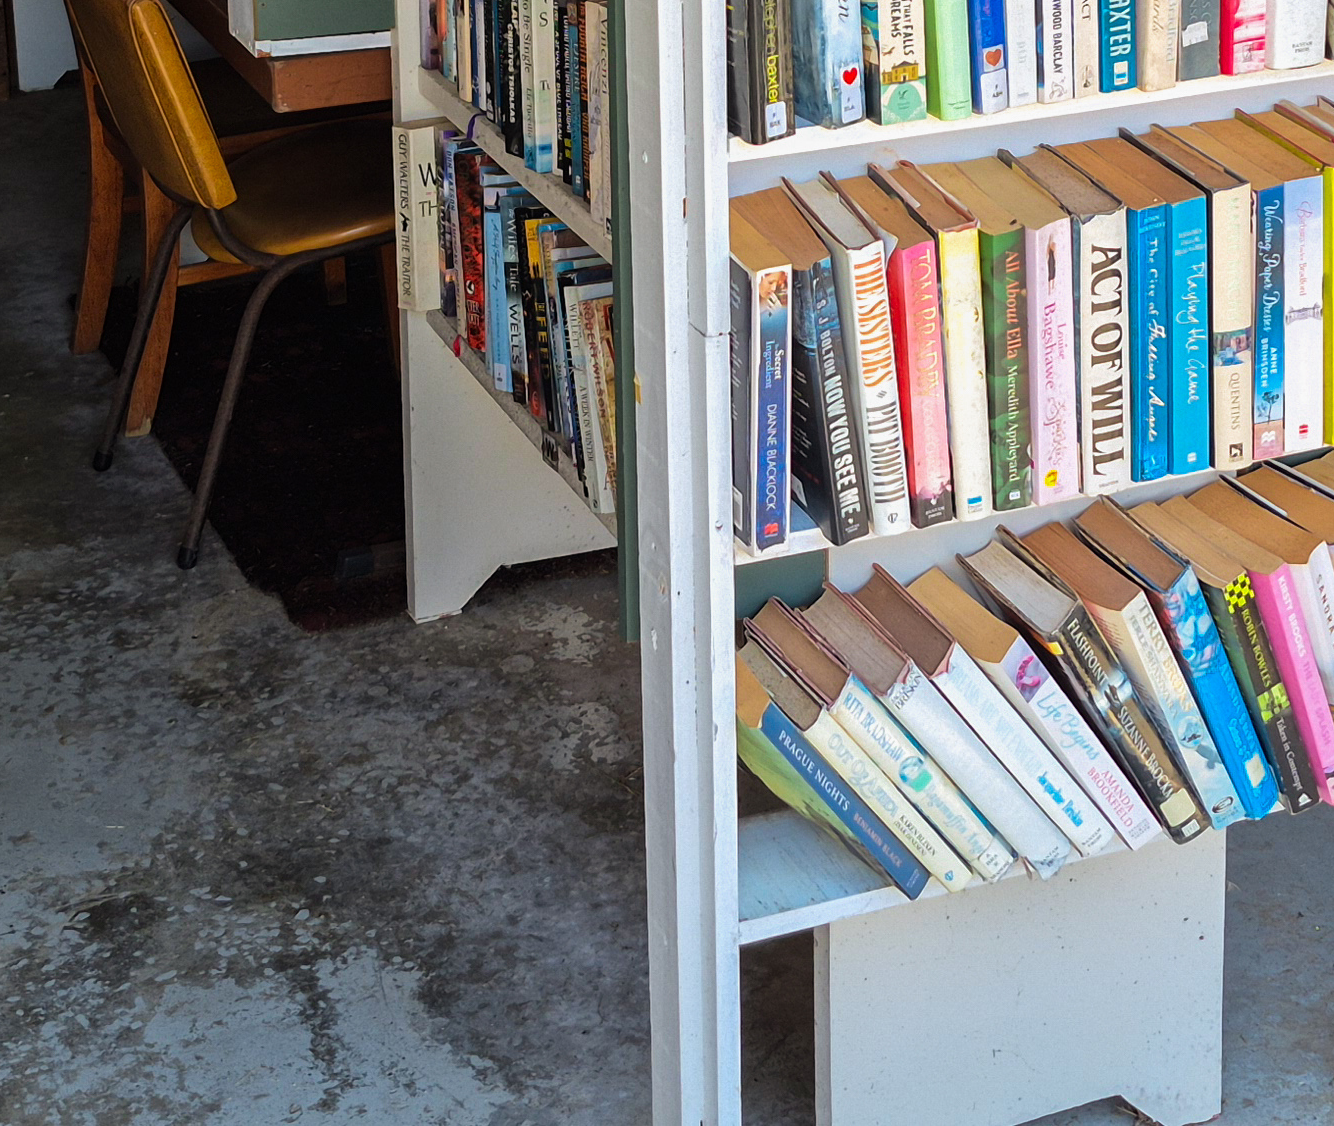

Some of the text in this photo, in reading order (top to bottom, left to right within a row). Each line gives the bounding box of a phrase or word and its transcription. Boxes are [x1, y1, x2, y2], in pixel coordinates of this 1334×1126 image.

[902, 24, 914, 56] FALLS
[903, 5, 911, 23] THAT
[1051, 32, 1063, 74] BARCLAY
[398, 134, 410, 210] GUY WALTERS
[402, 256, 412, 297] TRAITOR
[1005, 252, 1022, 360] All About Ella
[774, 349, 784, 380] Secret
[1043, 302, 1057, 391] Bagshawe
[1089, 244, 1125, 476] ACT OF WILL
[1260, 337, 1269, 388] BRINSDEN
[1269, 346, 1278, 374] ANNE
[1006, 366, 1020, 483] Meredith Appleyard
[1229, 372, 1240, 431] QUENTINS
[766, 404, 778, 511] DIANNE BLACKLOCK
[824, 375, 861, 519] NOW YOU SEE ME
[1278, 577, 1306, 658] KIRSTY BROOKS
[1067, 618, 1108, 686] FLASHPOINT
[778, 730, 851, 811] PRAGUE NIGHTS
[1086, 766, 1135, 829] BROOKFIELD
[1099, 768, 1136, 814] AMANDA
